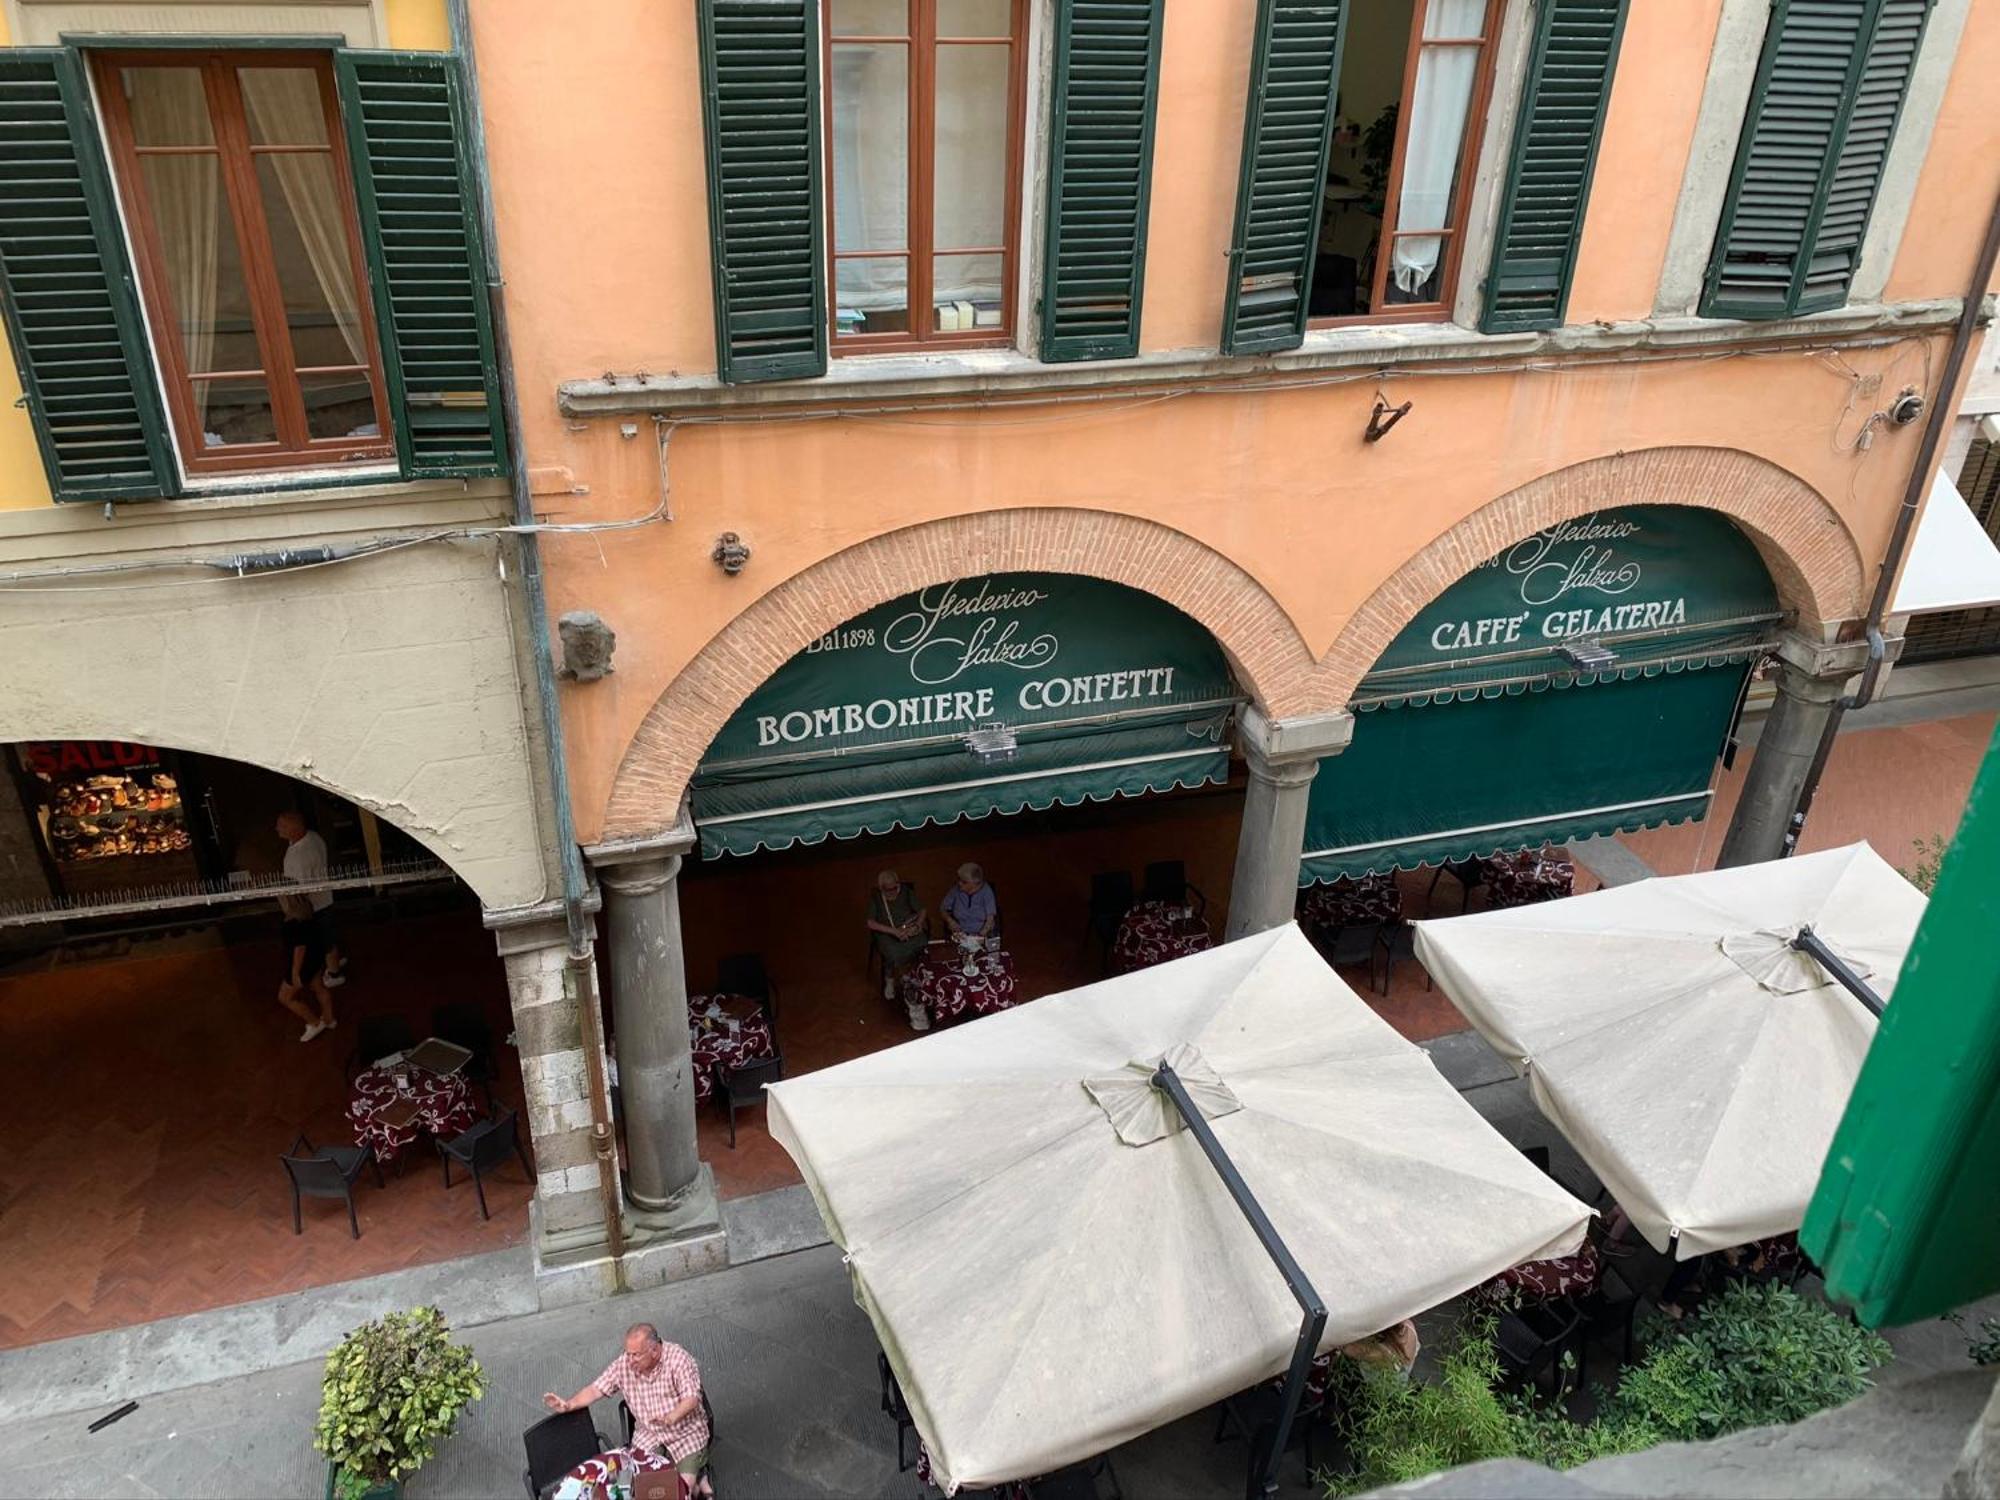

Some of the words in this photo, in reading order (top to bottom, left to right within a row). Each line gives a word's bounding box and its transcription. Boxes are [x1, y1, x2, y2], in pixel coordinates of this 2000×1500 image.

[1506, 511, 1641, 574] Federico
[1520, 544, 1641, 605] Salza
[806, 629, 840, 654] Dal
[842, 628, 876, 650] 1898
[884, 578, 1049, 653] Federico
[1431, 611, 1530, 651] CAFFE'
[1541, 598, 1687, 638] GELATERIA
[910, 616, 1059, 685] Salza
[756, 687, 995, 747] BOMBONIERE
[1018, 667, 1176, 712] CONFETTI
